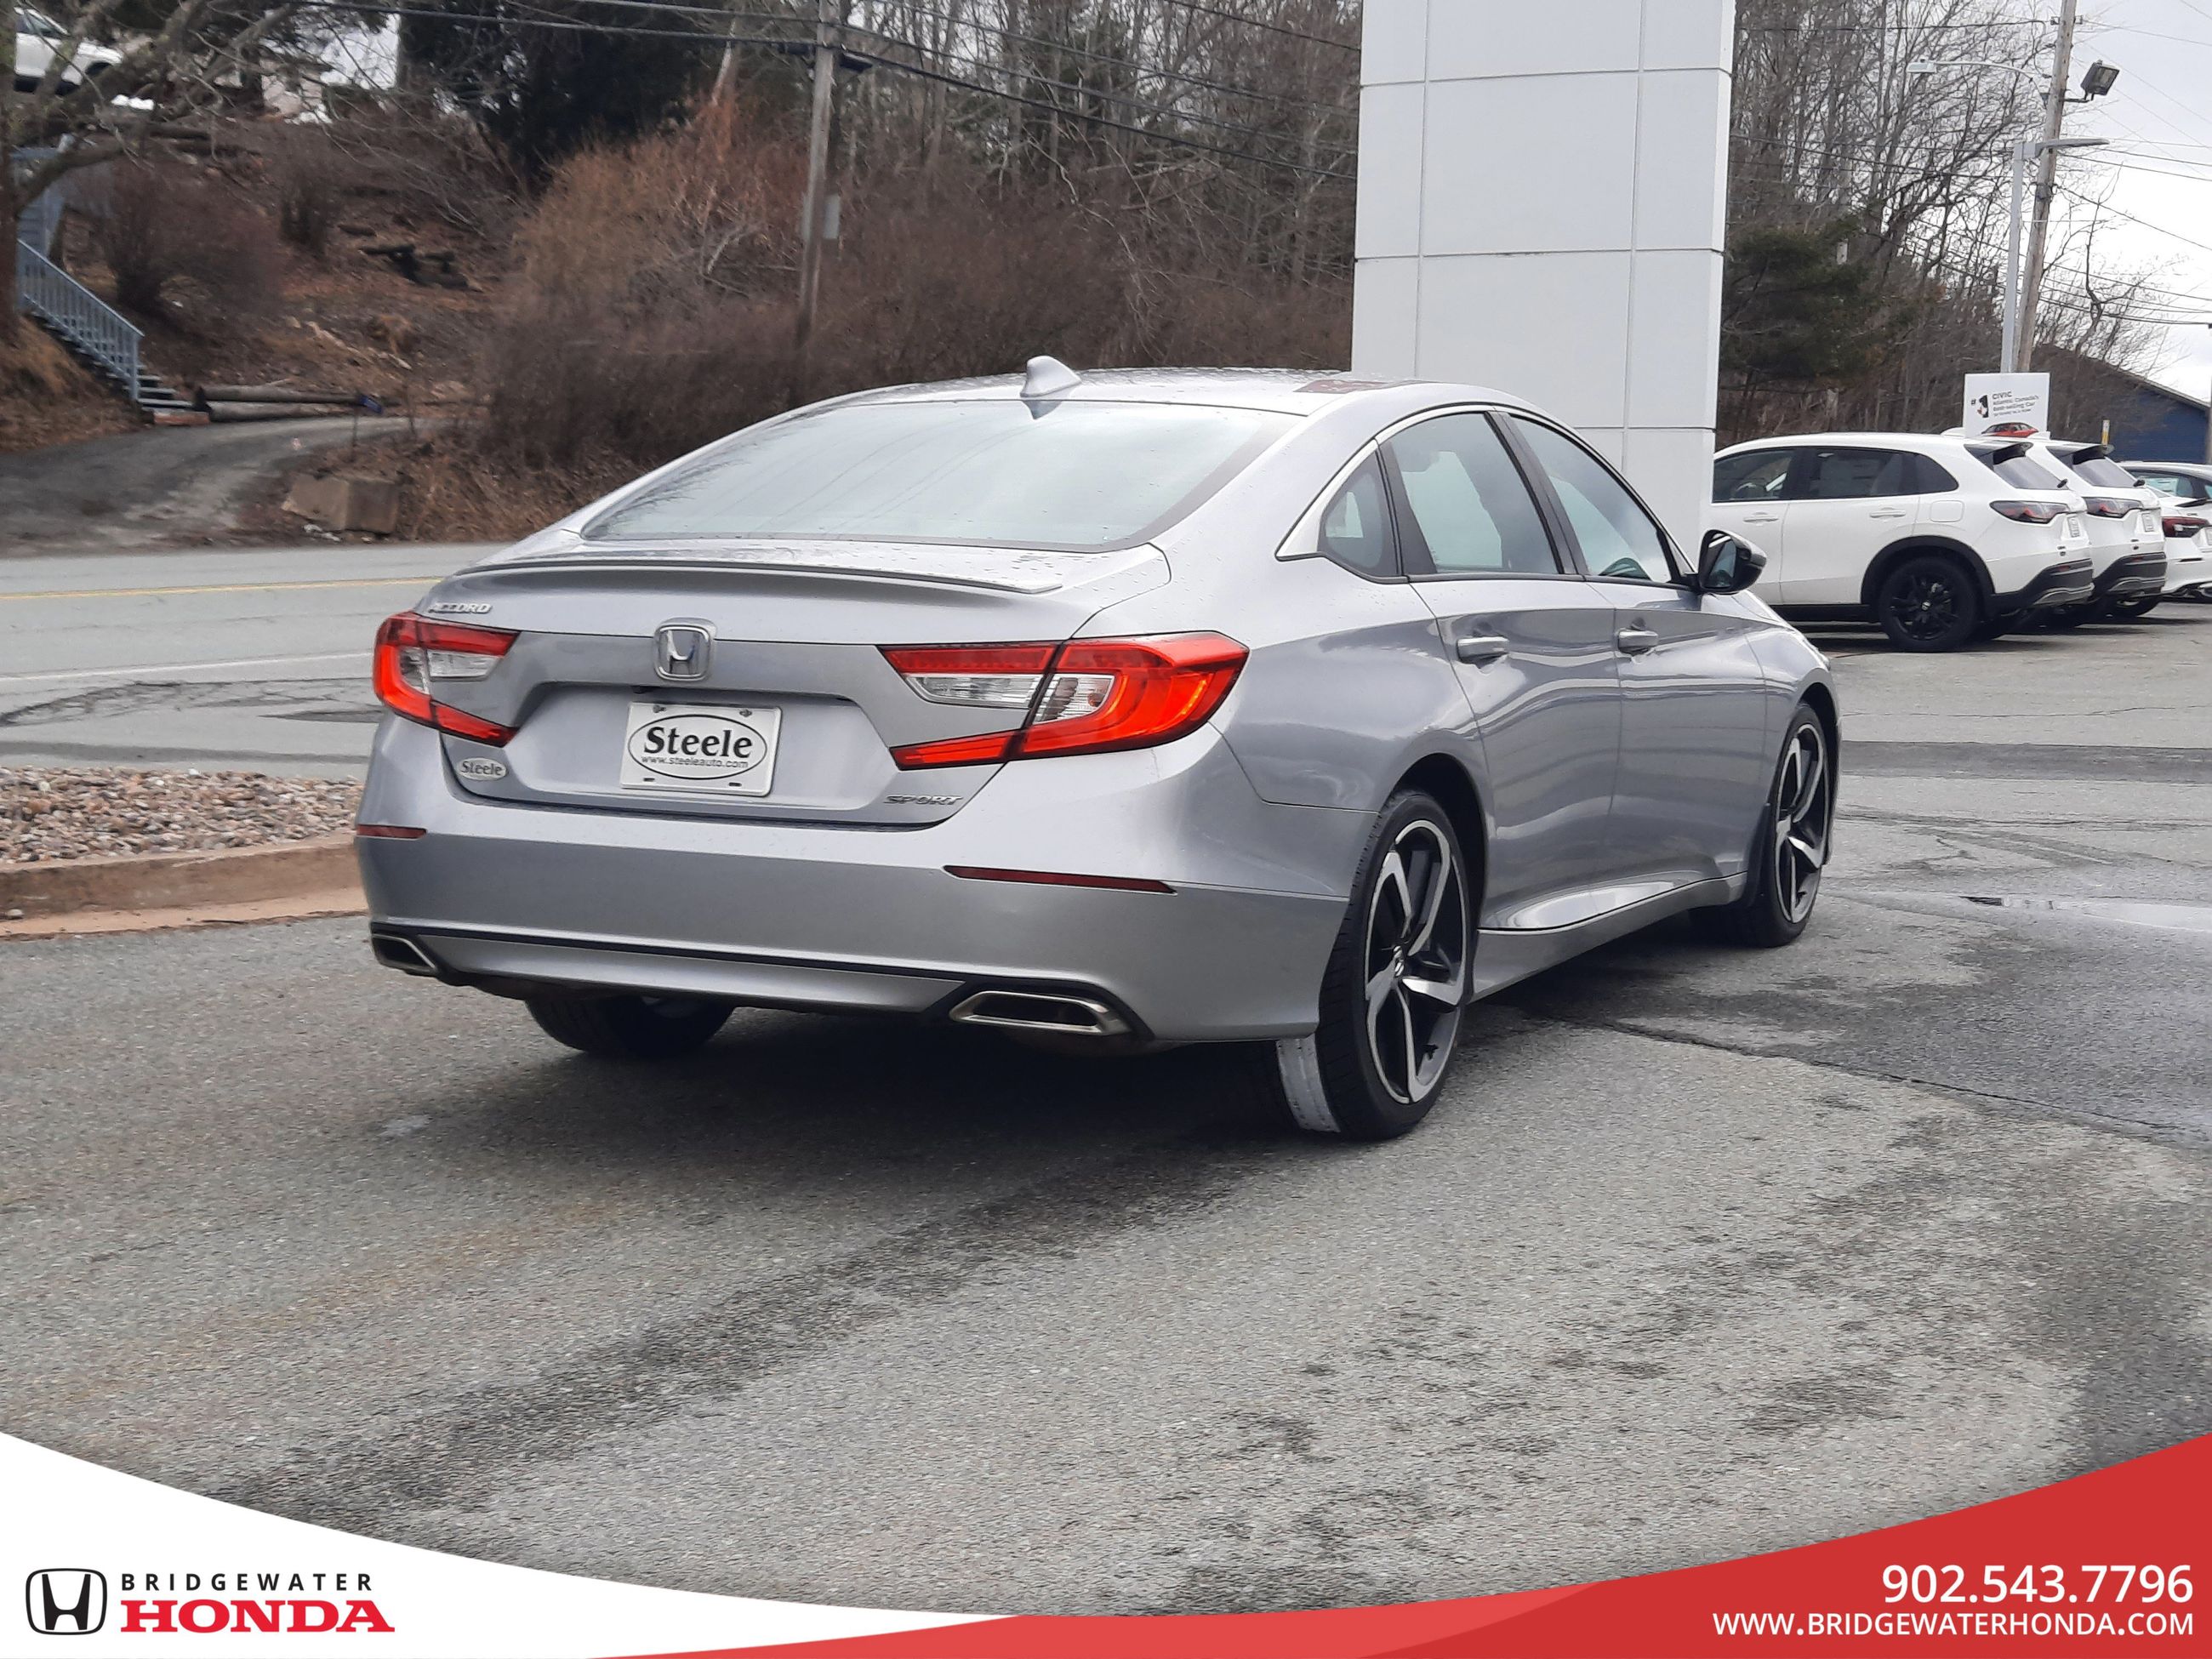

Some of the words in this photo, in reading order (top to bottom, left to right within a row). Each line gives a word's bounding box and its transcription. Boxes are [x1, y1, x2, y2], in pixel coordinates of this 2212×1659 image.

[1992, 391, 2012, 400] CIVIC
[643, 726, 753, 759] Steele
[460, 761, 504, 776] Steele
[641, 755, 750, 769] www.steeleauto.com
[883, 794, 964, 806] SPORT
